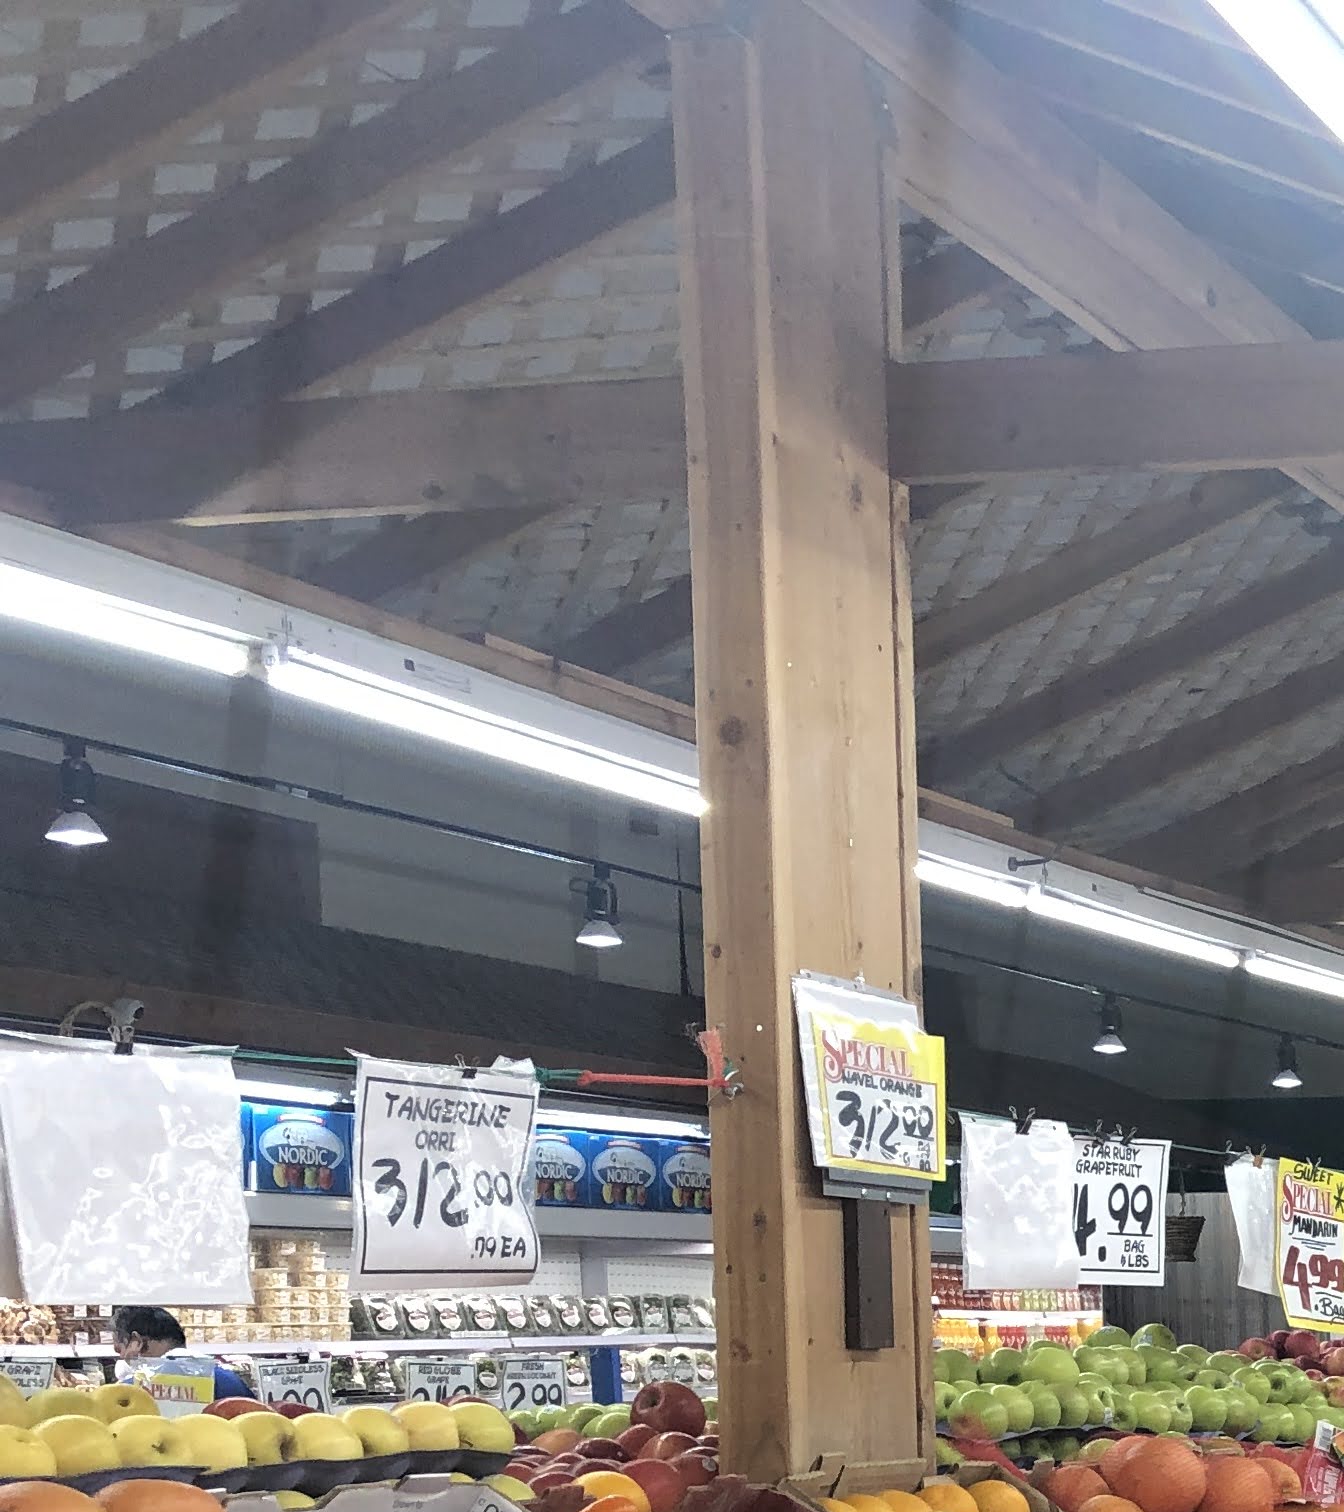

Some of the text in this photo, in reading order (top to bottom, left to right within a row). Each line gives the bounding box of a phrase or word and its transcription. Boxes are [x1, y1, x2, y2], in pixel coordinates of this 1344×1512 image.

[822, 1029, 913, 1084] SPECIAL
[842, 1071, 922, 1098] NAVEL ORANGE
[385, 1092, 511, 1128] TANGERINE
[415, 1130, 456, 1152] ORRI
[278, 1146, 328, 1165] NORDIC
[1083, 1144, 1141, 1162] STAR RUBY
[607, 1169, 644, 1184] NORDIC
[1076, 1159, 1142, 1178] GRAPEFRUIT
[1294, 1163, 1334, 1185] SWEET
[1282, 1174, 1335, 1224] SPECIAL
[1288, 1214, 1338, 1238] MANDARIN
[501, 1236, 526, 1258] EA
[1124, 1239, 1145, 1254] BAG
[1128, 1254, 1149, 1268] LBS
